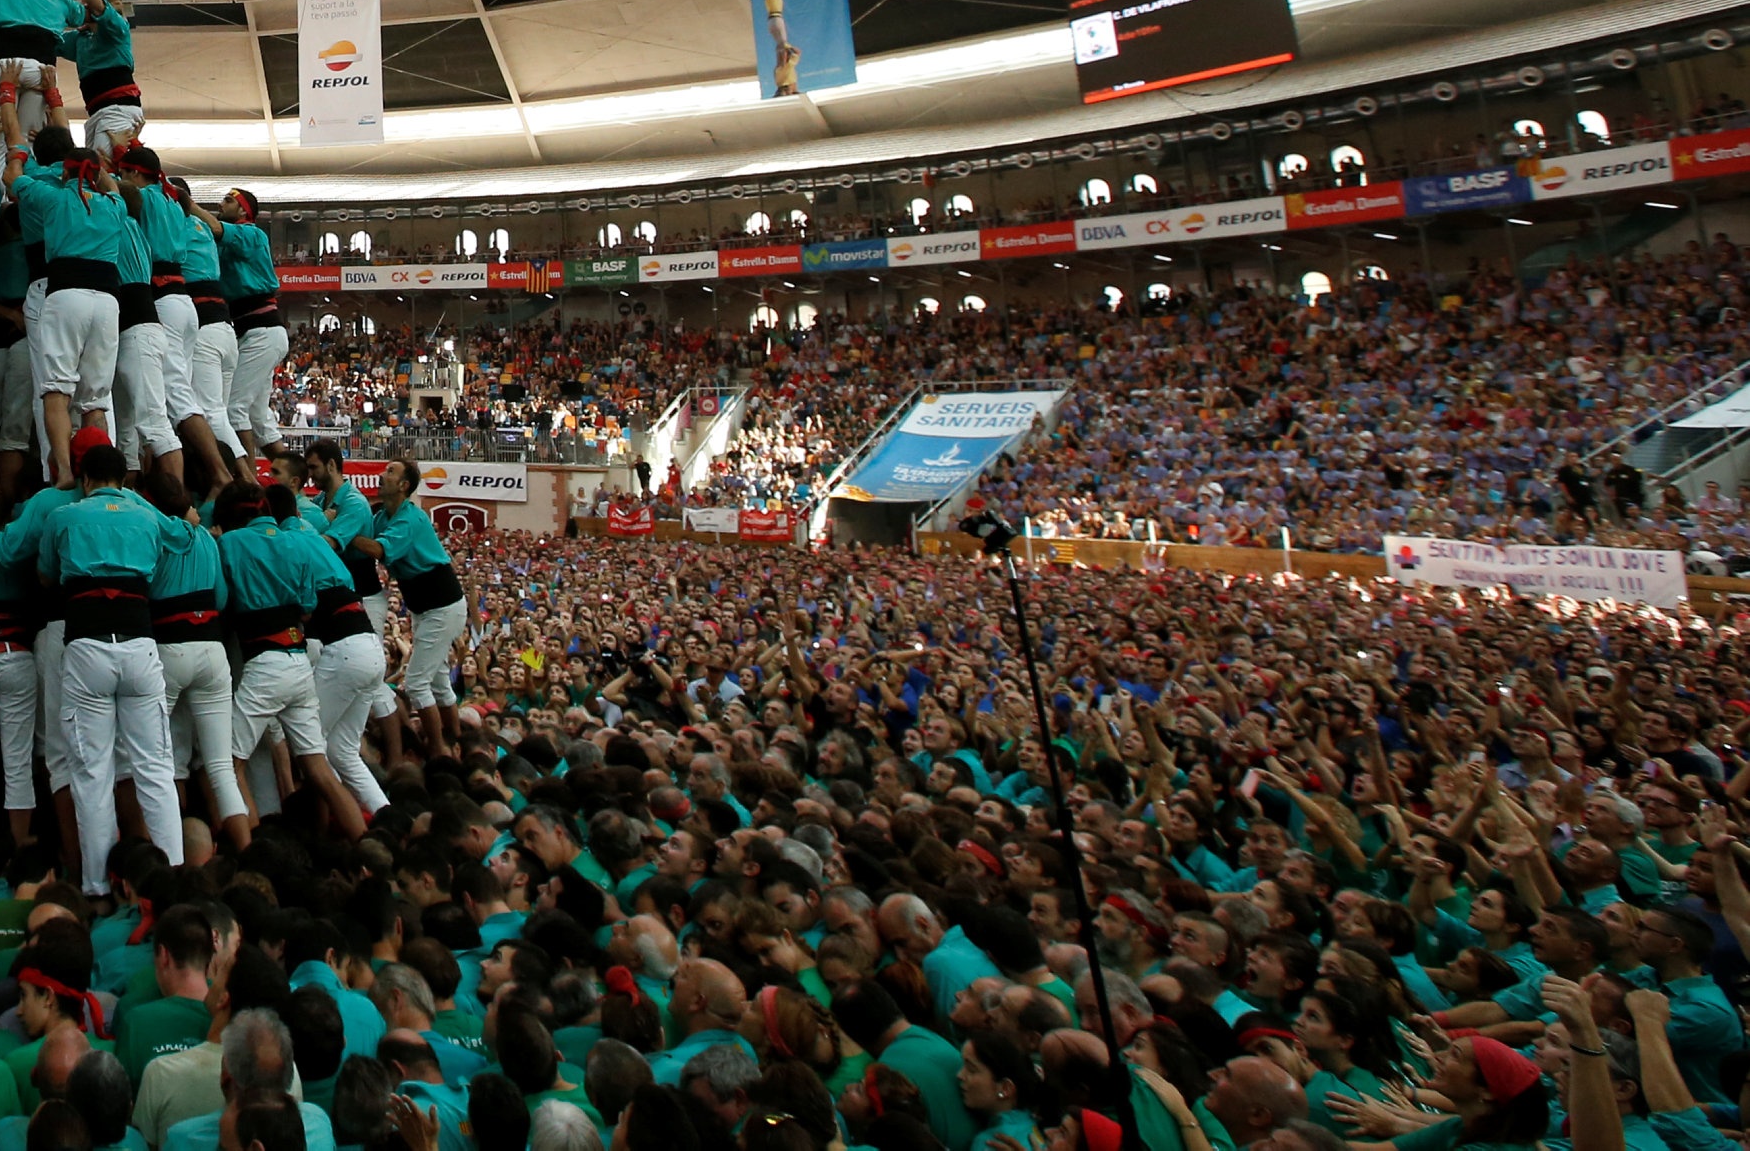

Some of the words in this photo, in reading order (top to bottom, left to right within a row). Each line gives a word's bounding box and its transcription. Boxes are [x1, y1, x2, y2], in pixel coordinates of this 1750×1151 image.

[312, 76, 370, 89] REPSOL
[1582, 157, 1669, 180] REPSOL
[1449, 170, 1510, 192] BASF
[1305, 200, 1354, 217] Estrella
[1081, 224, 1127, 241] BBVA
[1145, 219, 1171, 236] CX
[1217, 209, 1283, 226] REPSOL
[996, 234, 1037, 248] Estrella
[922, 242, 980, 255] REPSOL
[732, 256, 767, 268] Estrella
[768, 255, 799, 266] Damm
[830, 250, 885, 262] movistar
[592, 260, 627, 273] BASF
[669, 261, 717, 273] REPSOL
[282, 274, 313, 284] Estrella
[314, 273, 340, 284] Damm
[345, 272, 378, 284] BBVA
[391, 271, 409, 282] CX
[441, 270, 486, 281] REPSOL
[499, 269, 528, 280] Estrell
[938, 401, 1036, 415] SERVEIS
[459, 475, 525, 489] REPSOL
